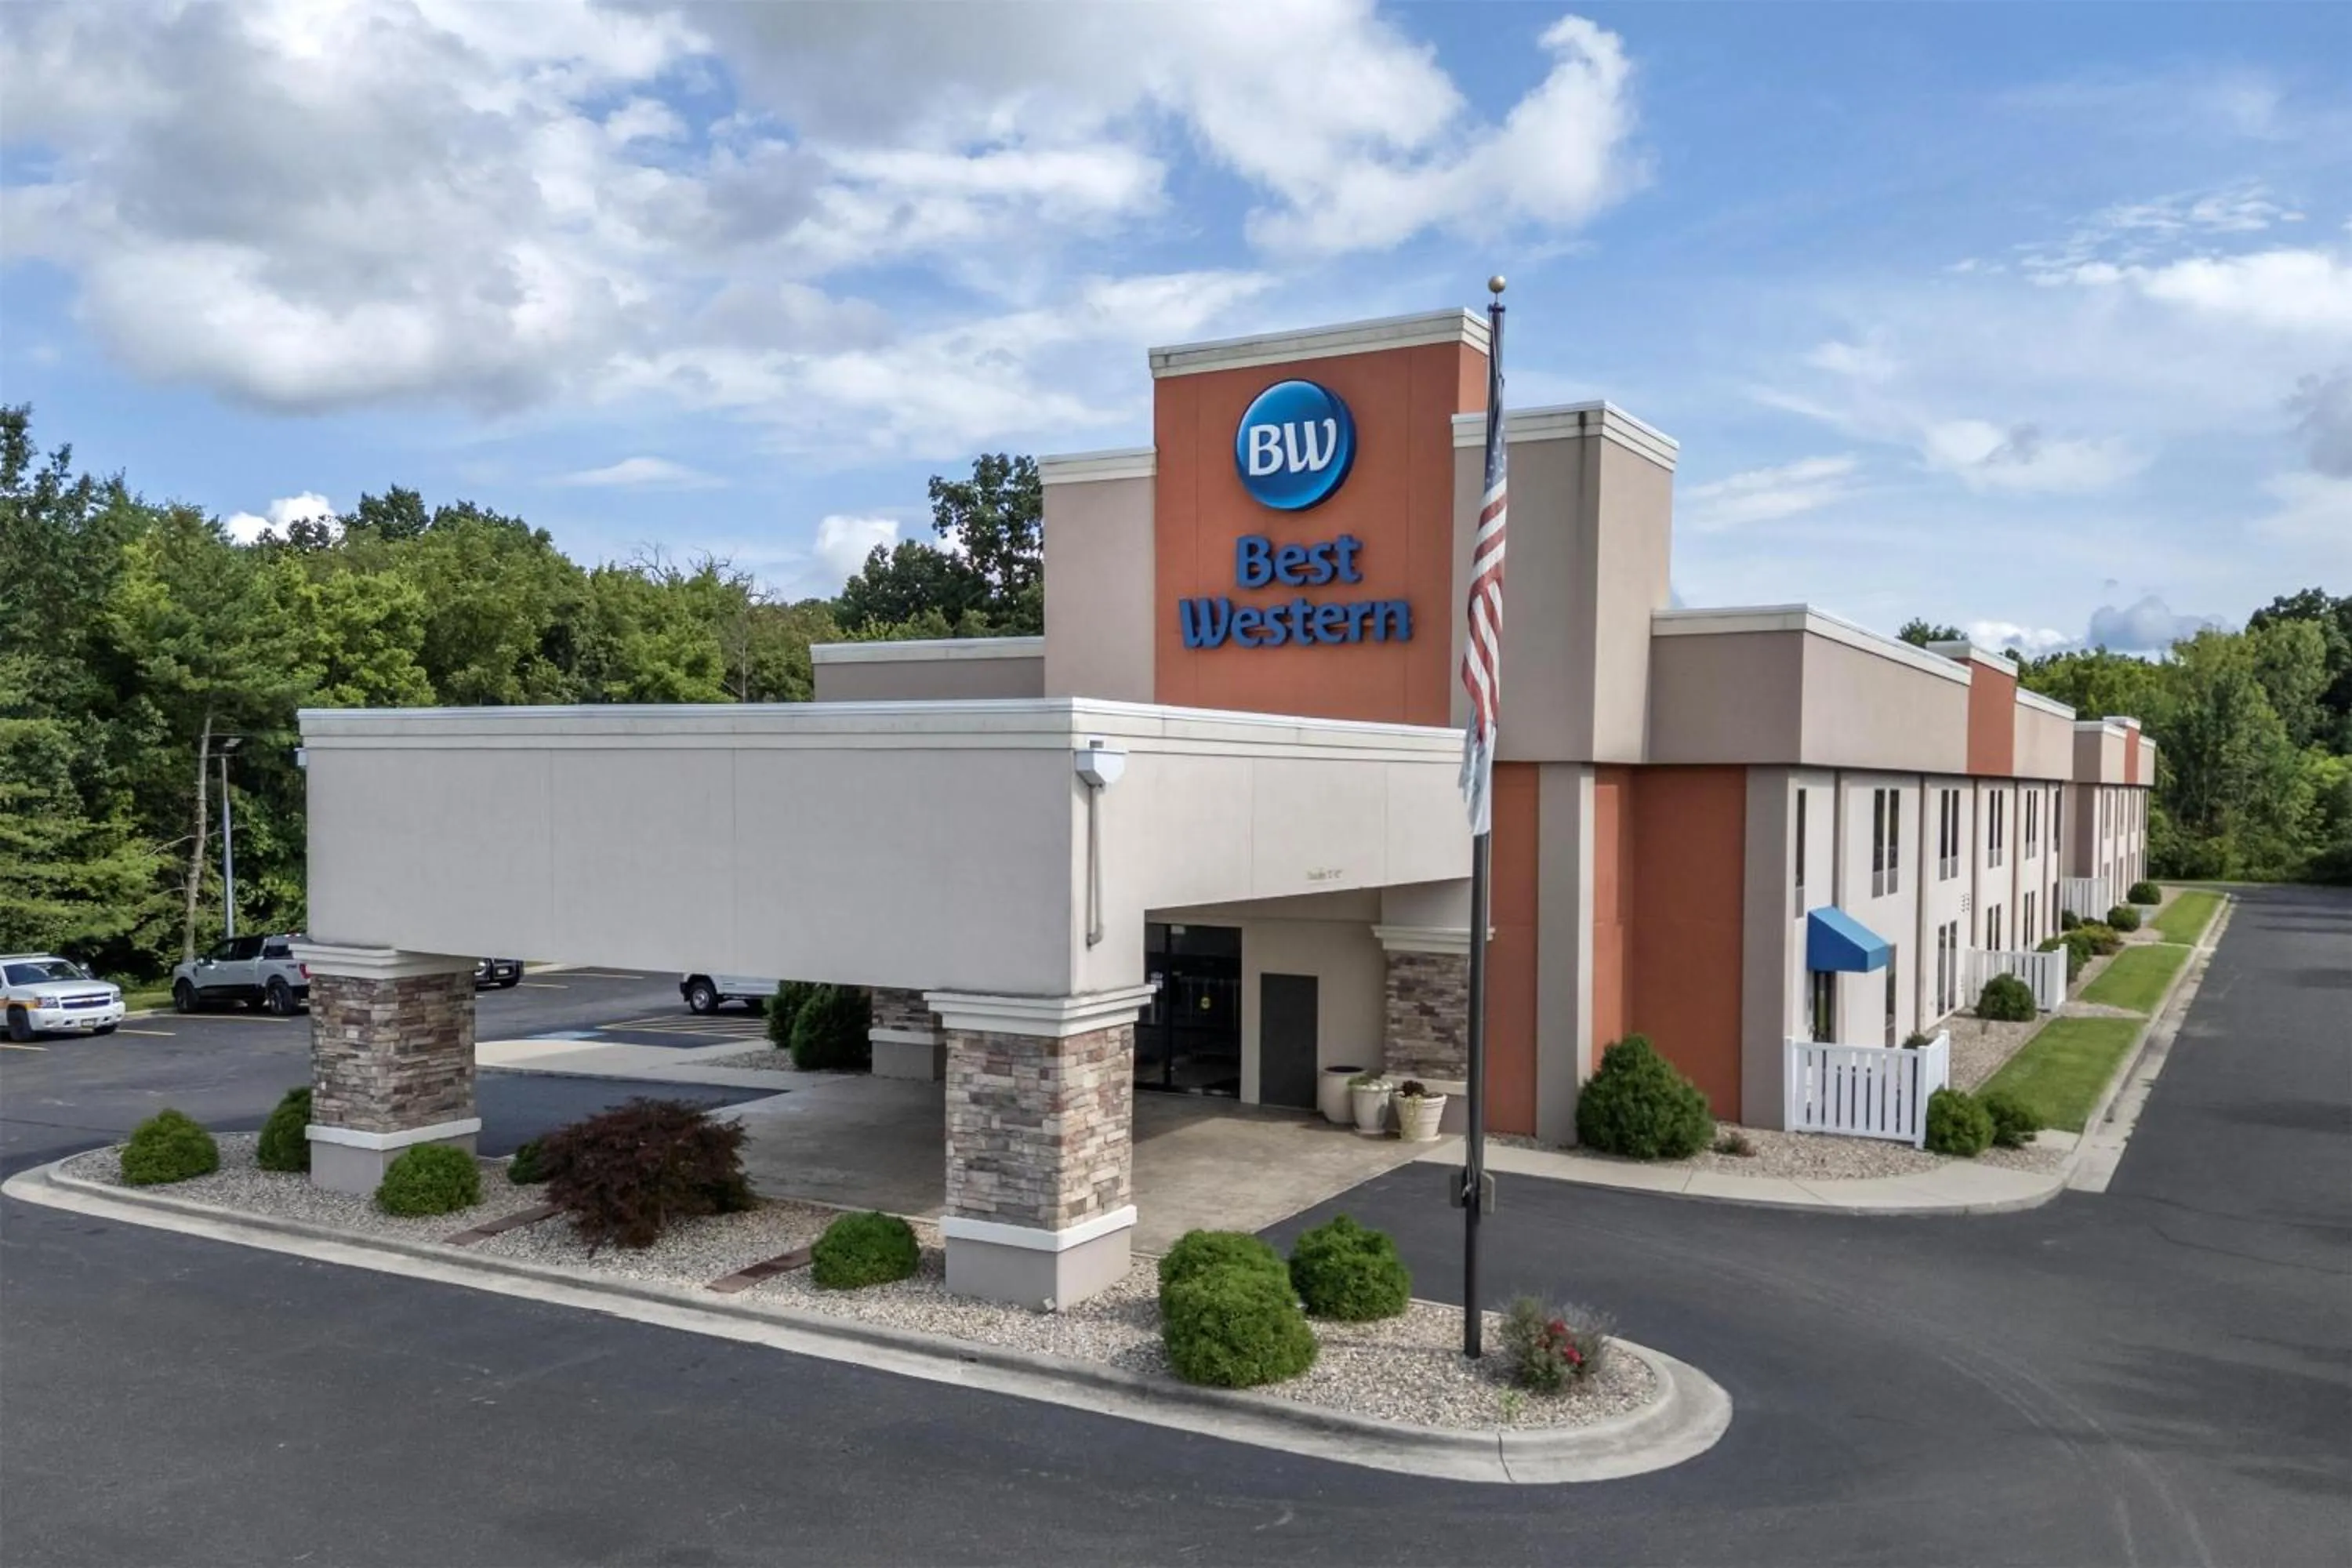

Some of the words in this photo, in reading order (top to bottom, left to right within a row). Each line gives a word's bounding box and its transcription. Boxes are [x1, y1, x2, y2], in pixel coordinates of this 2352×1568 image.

[1249, 418, 1337, 476] BW
[1236, 534, 1363, 588] Best
[1178, 596, 1413, 650] Western
